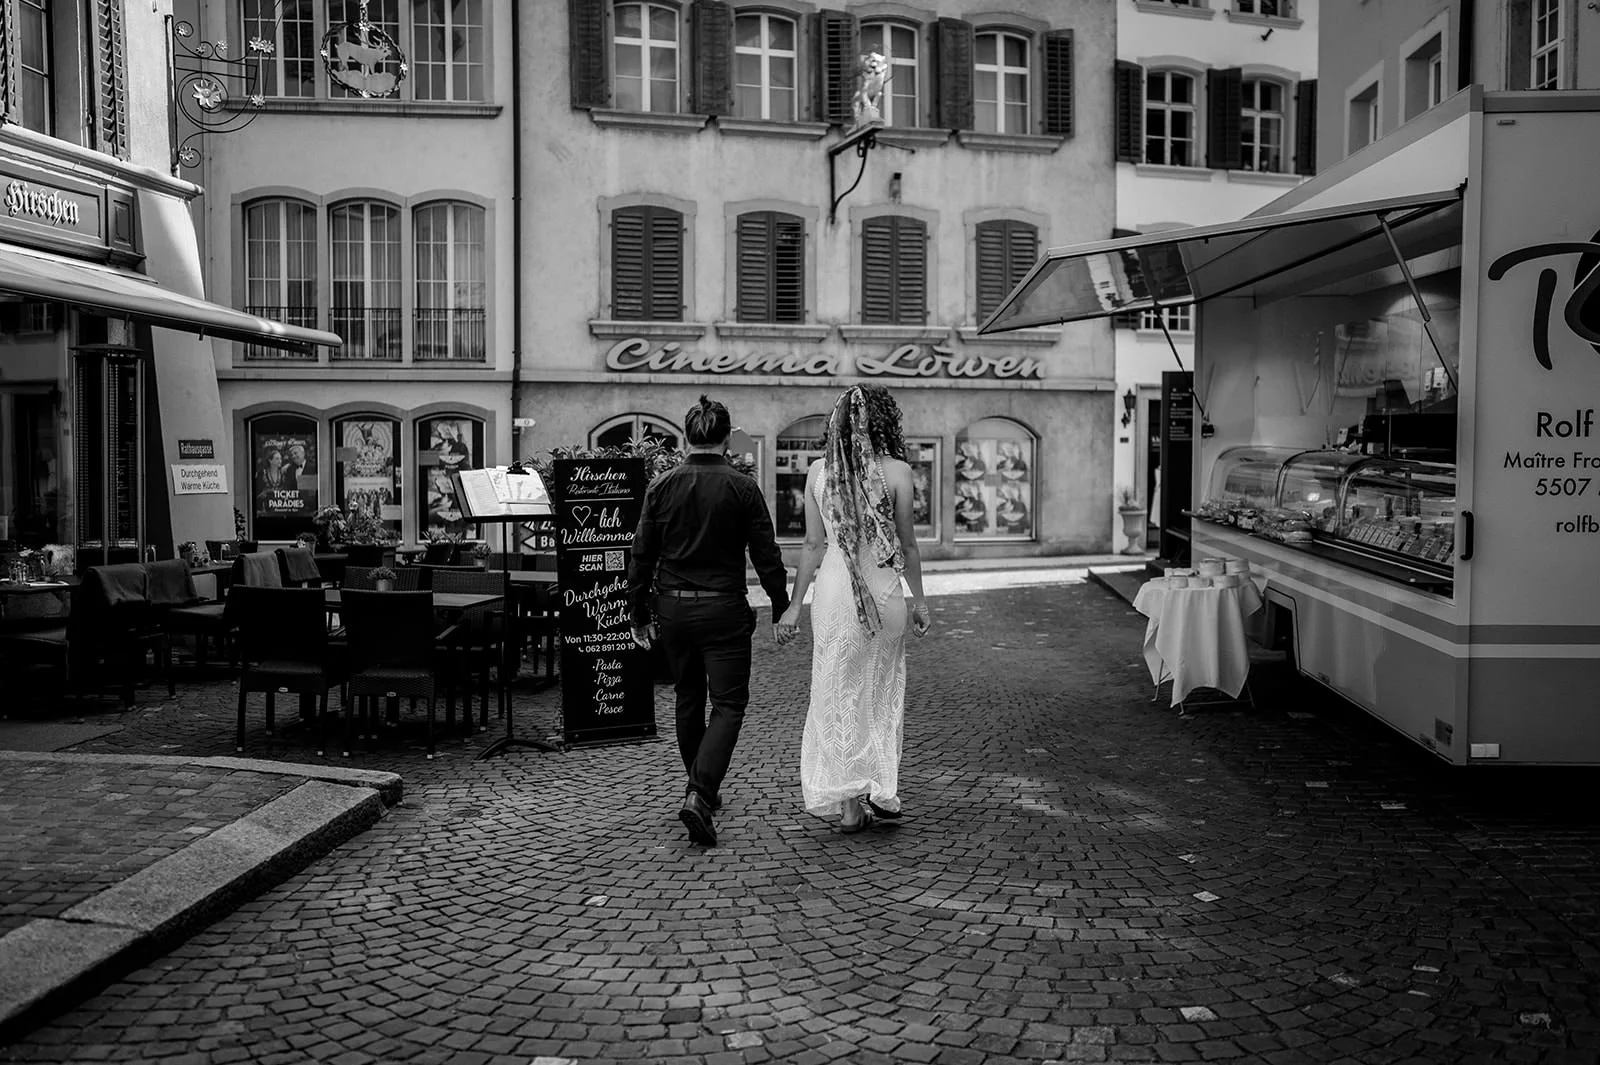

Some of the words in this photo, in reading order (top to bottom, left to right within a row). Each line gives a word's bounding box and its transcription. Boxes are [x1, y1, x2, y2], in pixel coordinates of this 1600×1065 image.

[6, 180, 80, 226] Hirschen
[605, 337, 840, 377] Cinema
[858, 344, 1047, 379] Löwen
[1536, 409, 1594, 438] Rolf
[1503, 451, 1566, 469] Maître
[180, 468, 218, 480] Durchgehend
[569, 465, 627, 482] Hirschen
[273, 489, 300, 498] TICKET
[1535, 478, 1592, 496] 5507
[268, 499, 305, 508] PARADIES
[1556, 514, 1600, 533] rolfb
[581, 554, 603, 563] HIER
[578, 563, 604, 572] SCAN
[582, 599, 628, 618] Warm
[564, 635, 582, 644] Von
[582, 631, 631, 643] 11:30-22:00
[585, 645, 601, 653] 062
[601, 644, 615, 652] 891
[615, 643, 627, 651] 20
[627, 642, 636, 650] 19
[595, 658, 623, 672] Pasta
[596, 672, 623, 687] Pizza
[595, 688, 625, 702] Carne
[597, 702, 624, 716] Pesce
